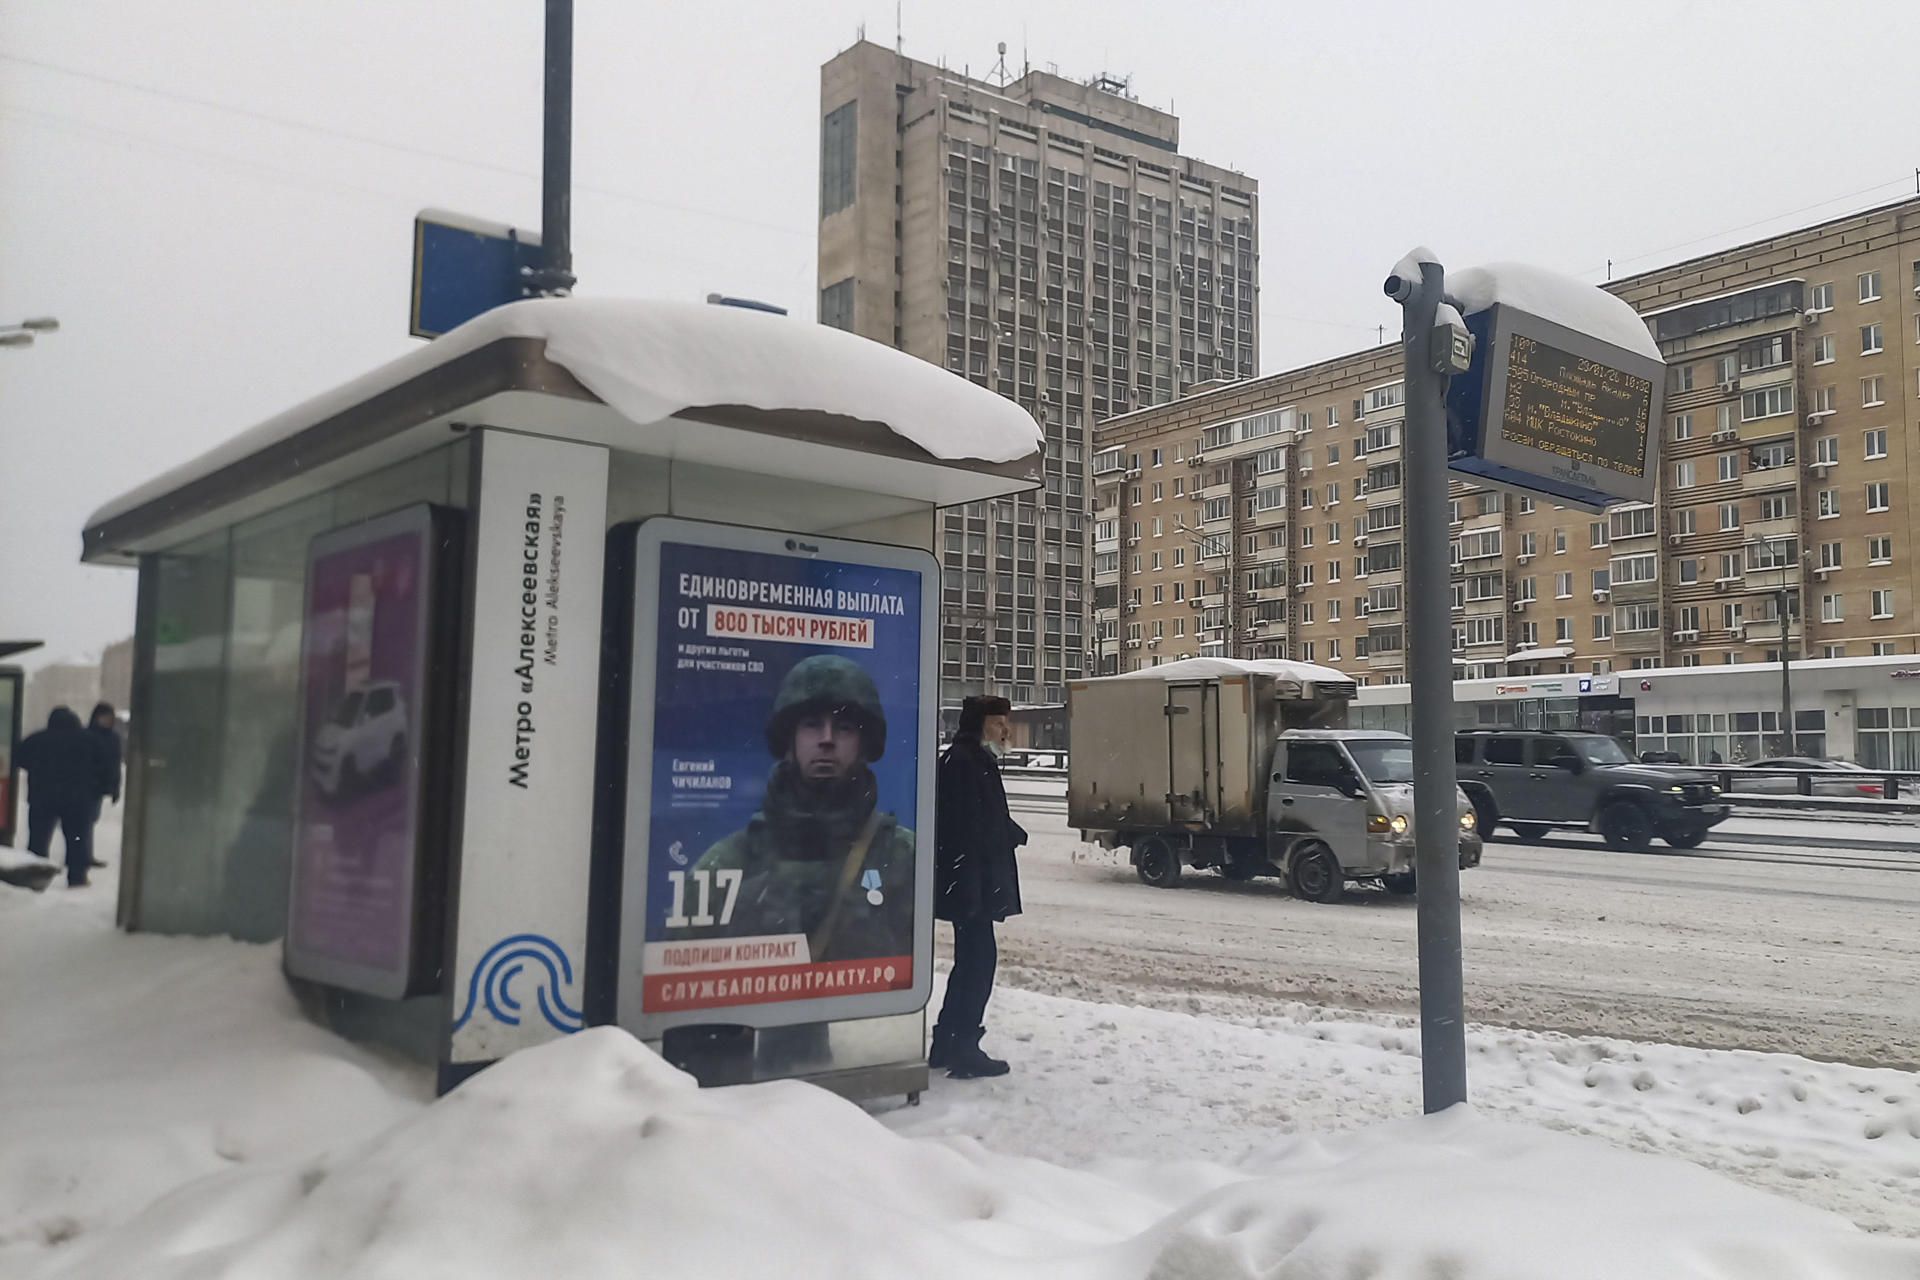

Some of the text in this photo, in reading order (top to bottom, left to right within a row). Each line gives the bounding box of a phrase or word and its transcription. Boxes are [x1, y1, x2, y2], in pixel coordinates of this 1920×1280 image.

[1510, 350, 1527, 365] 414
[1637, 448, 1644, 461] 2
[544, 495, 566, 665] Metro Alekseevskaya
[680, 573, 904, 616] ЕДИНОВРЕМЕННАЯ ВЫПЛАТА
[678, 607, 867, 643] ОТ 800 ТЫСЯЧ РУБЛЕЙ
[509, 493, 542, 789] Метро «Алексеевская»
[686, 644, 716, 656] другие
[718, 647, 750, 657] льготы
[677, 658, 765, 673] для участников СВО
[672, 759, 715, 772] Евгений
[665, 870, 743, 928] 117
[663, 941, 797, 967] ПОДПИШИ КОНТРАКТ
[662, 965, 896, 1002] СЛУЖБАПОКОНТРАКТУ.РФ
